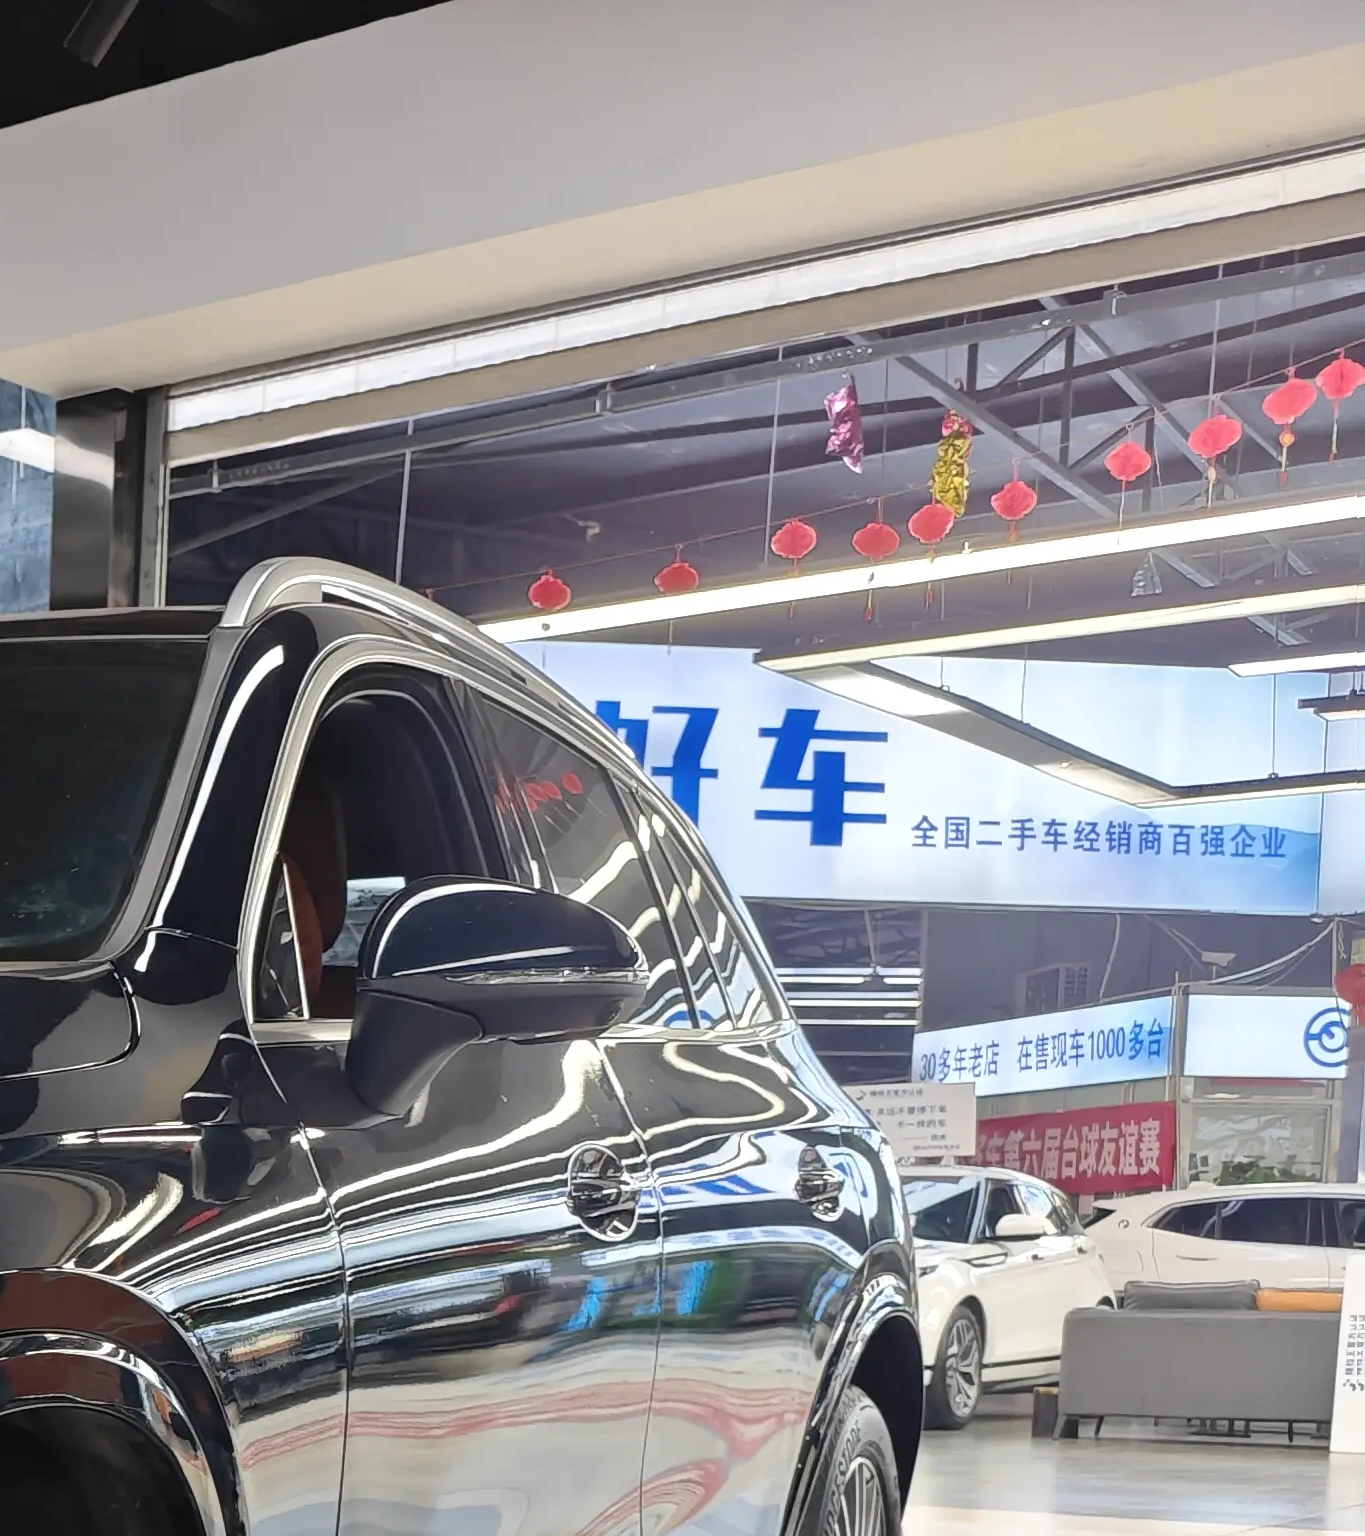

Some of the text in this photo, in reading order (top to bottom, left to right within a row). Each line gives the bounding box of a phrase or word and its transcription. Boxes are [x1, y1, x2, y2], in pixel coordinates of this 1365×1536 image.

[911, 815, 1287, 858] 全国二手车经销商百强企业
[920, 1018, 1164, 1082] 30多年老店 在售现车1000多台
